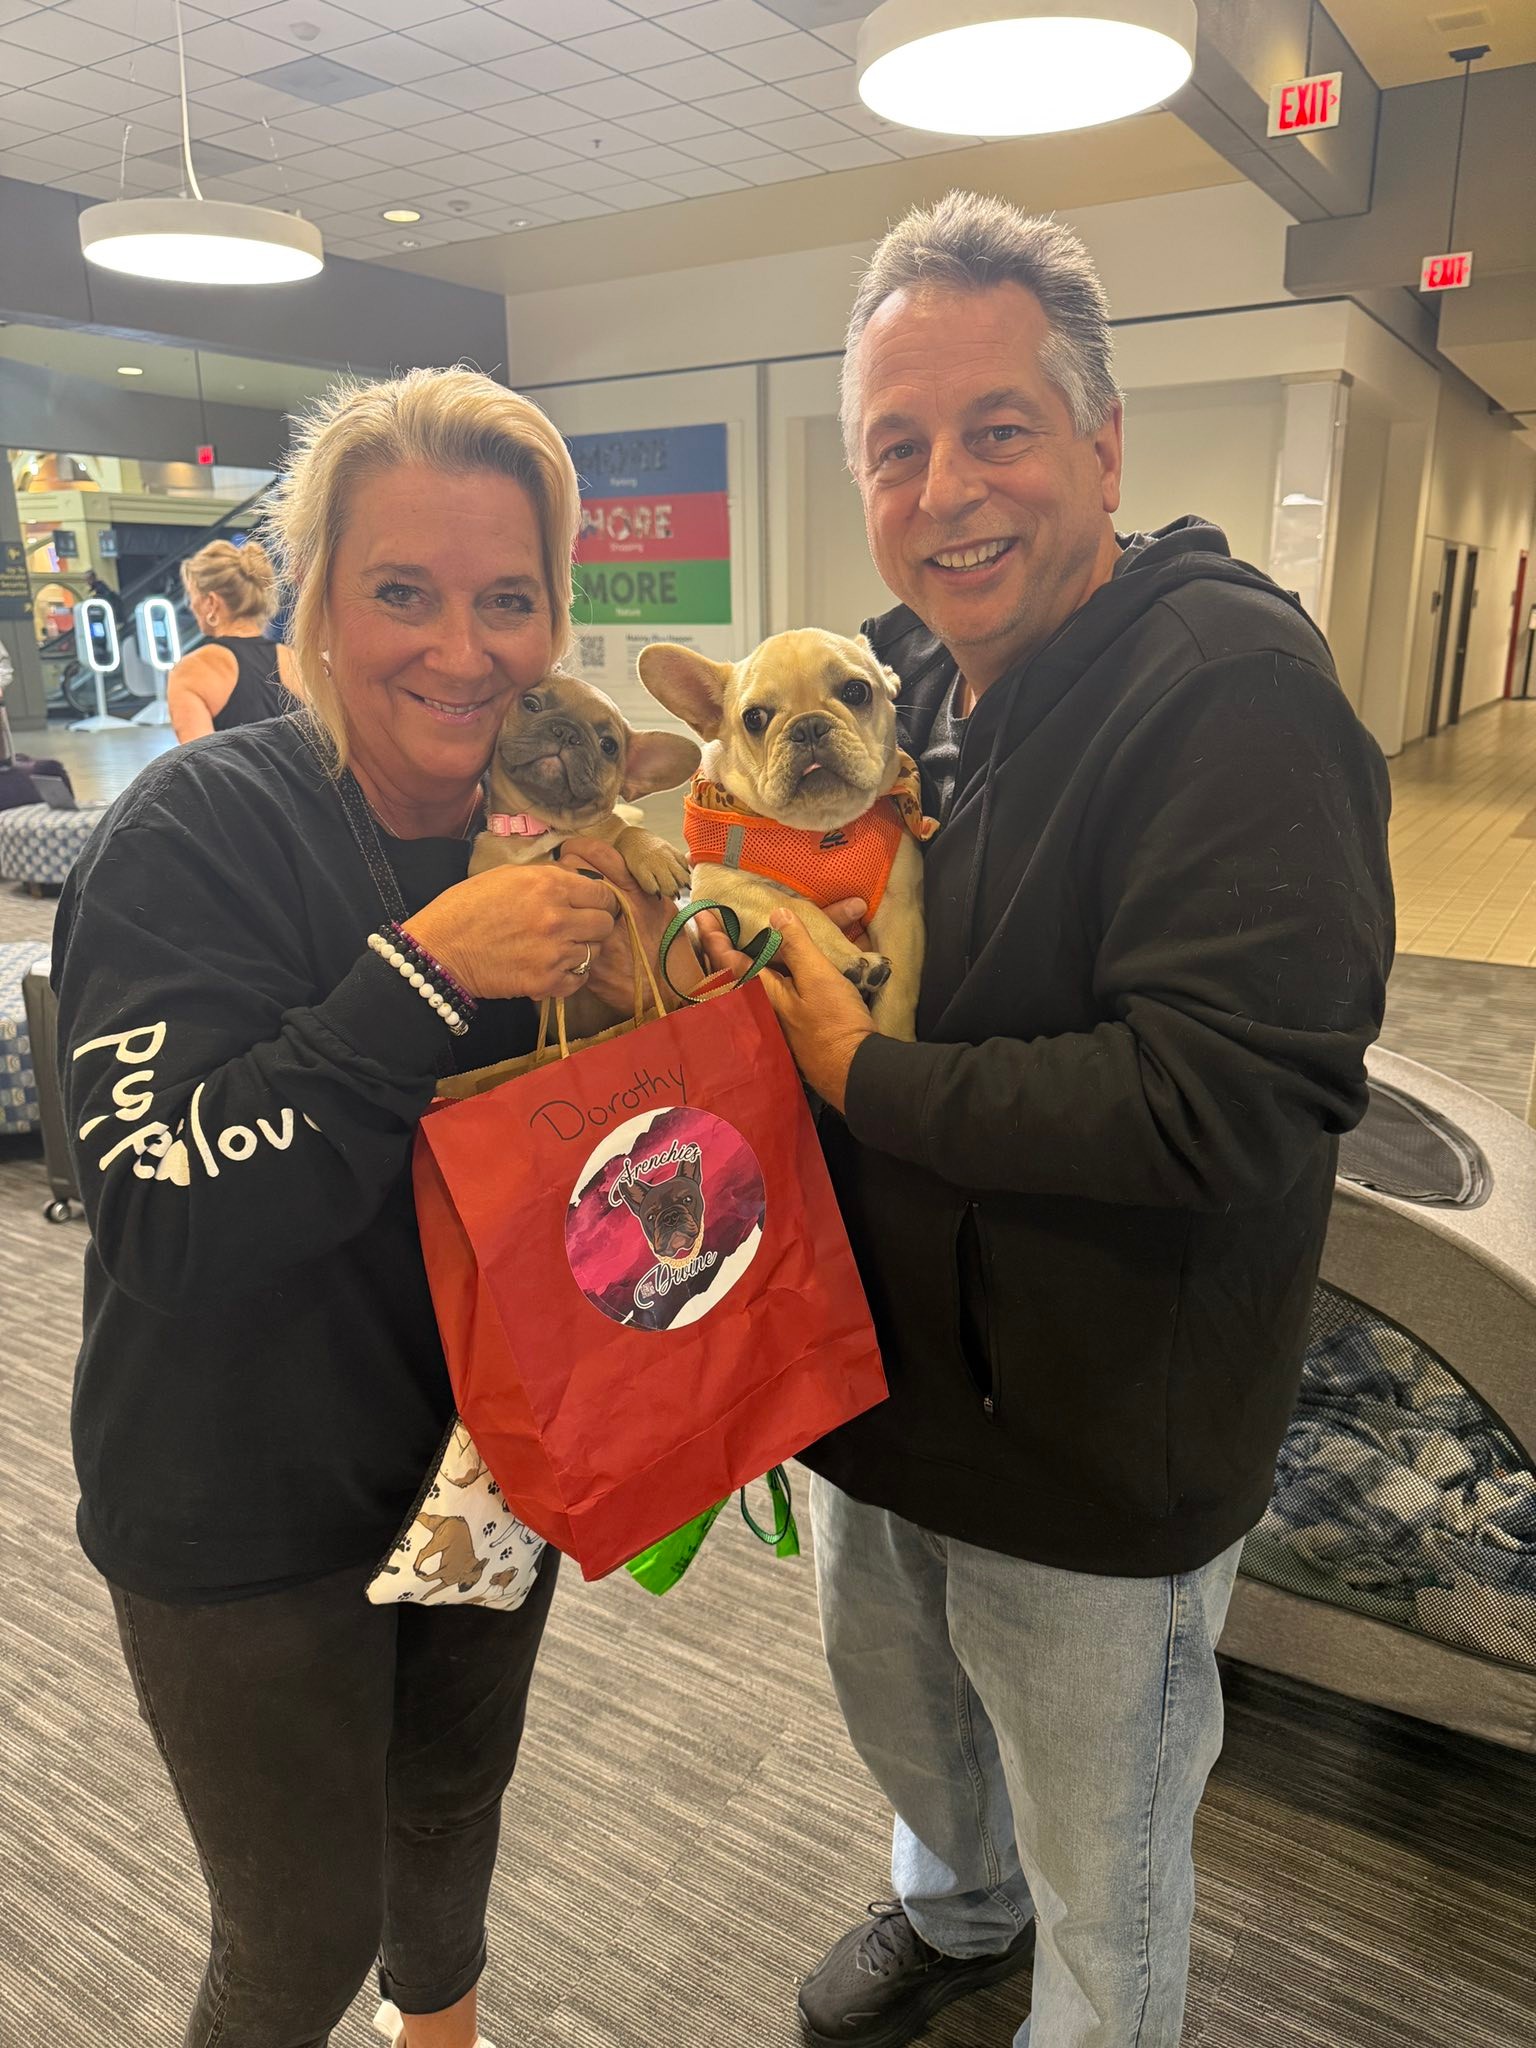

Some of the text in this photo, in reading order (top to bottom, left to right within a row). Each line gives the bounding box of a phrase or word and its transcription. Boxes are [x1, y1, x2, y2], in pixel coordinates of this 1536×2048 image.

[1279, 79, 1333, 130] EXIT
[1428, 256, 1466, 288] EXIT
[582, 570, 678, 605] MORE
[190, 1082, 323, 1178] lov
[529, 1063, 688, 1141] Dorothy
[608, 1139, 703, 1208] Frenchies
[633, 1251, 719, 1310] Divine
